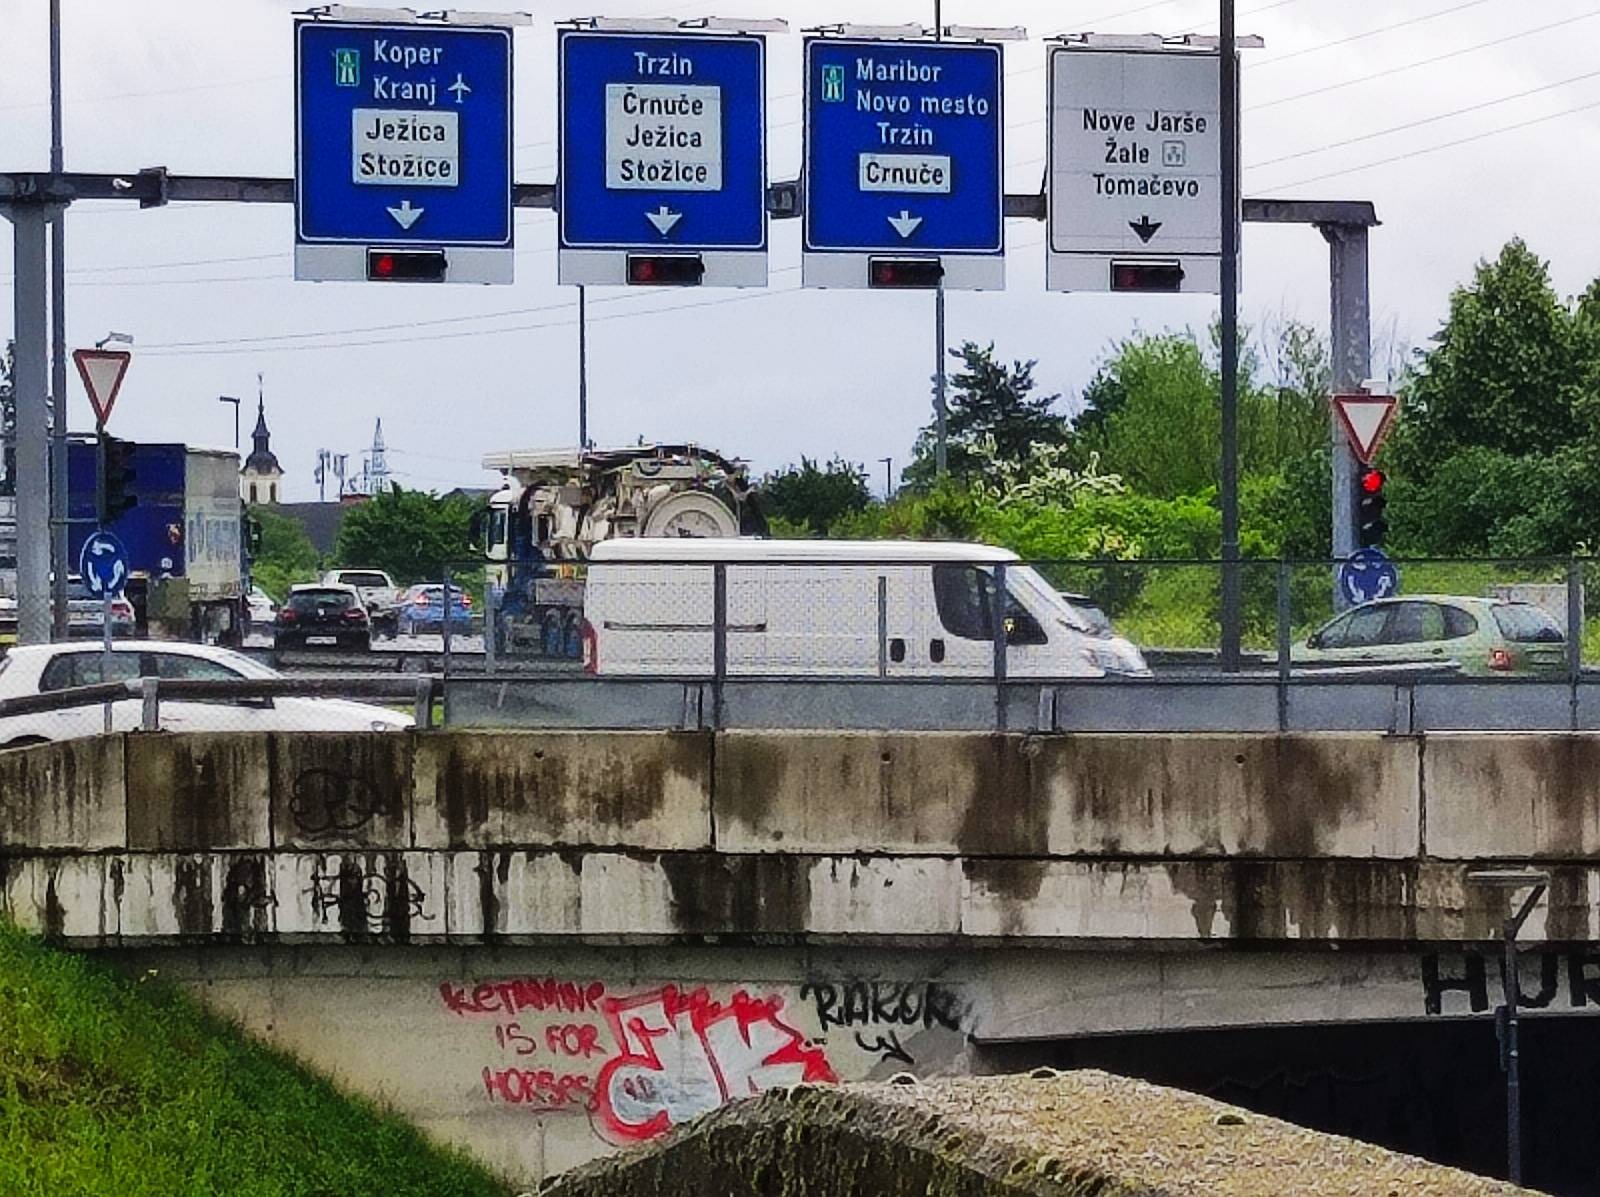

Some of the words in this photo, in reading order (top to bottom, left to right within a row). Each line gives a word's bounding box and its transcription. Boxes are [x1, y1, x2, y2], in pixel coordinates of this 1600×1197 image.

[373, 40, 443, 64] Koper
[634, 52, 693, 76] Trzin
[857, 59, 941, 82] Maribor
[373, 75, 437, 105] Kranj
[623, 87, 704, 116] Črnuče
[857, 91, 910, 113] Novo
[920, 96, 989, 116] mesto
[366, 117, 445, 142] Ježica
[876, 122, 933, 145] Trzin
[1083, 110, 1135, 131] Nove
[1146, 111, 1207, 133] Jarše
[626, 123, 702, 148] Ježica
[1105, 137, 1150, 164] Žale
[360, 153, 451, 178] Stožice
[620, 158, 707, 183] Stožice
[1093, 174, 1199, 197] Tomačevo
[495, 1022, 537, 1055] IS
[545, 1023, 607, 1058] FOR
